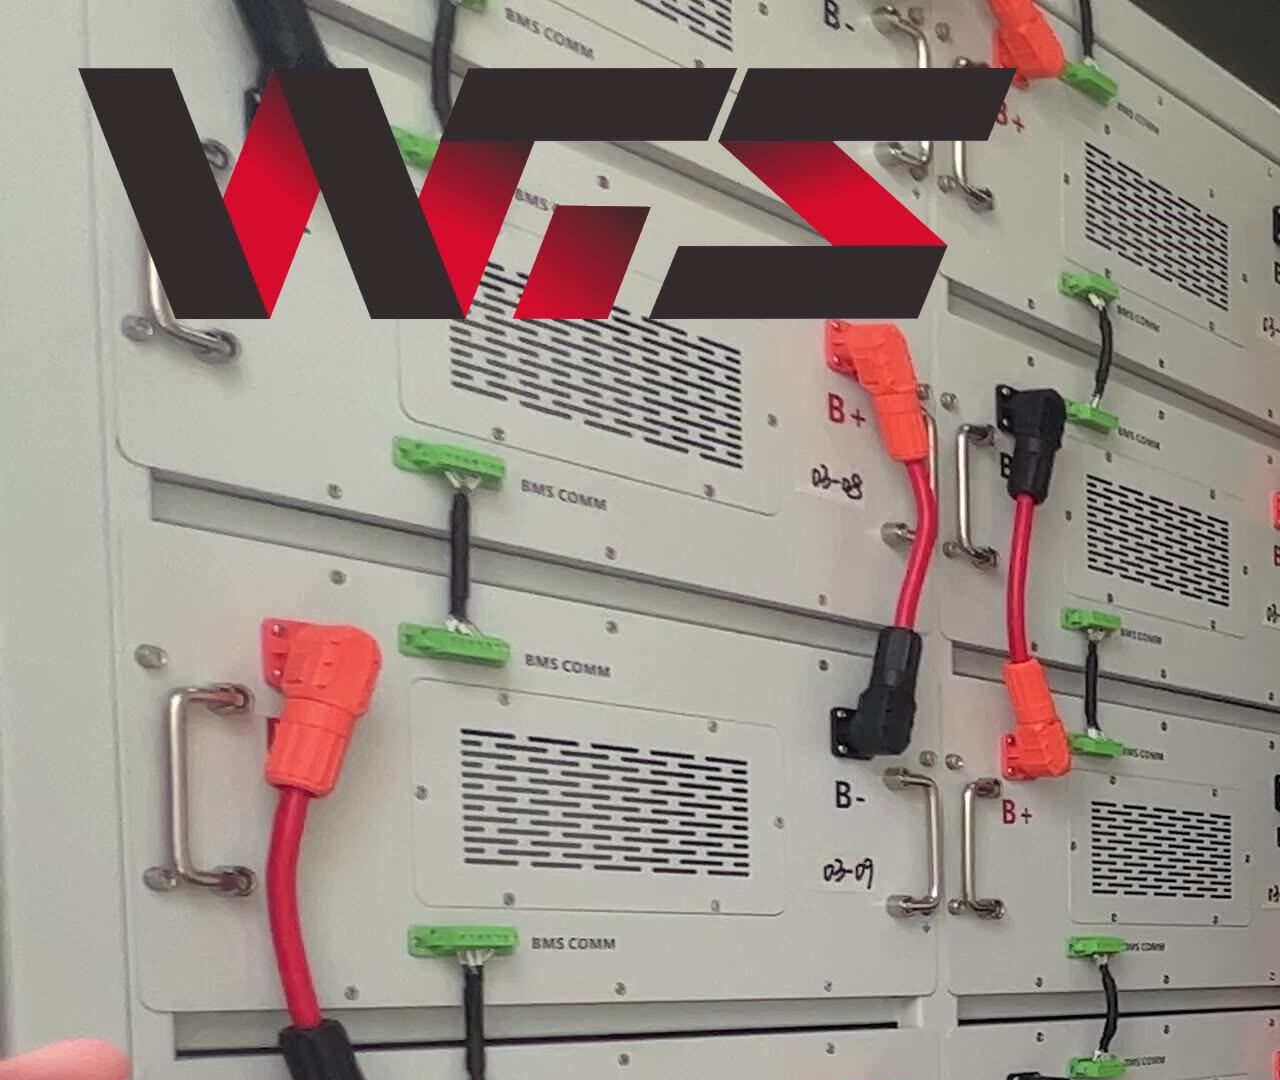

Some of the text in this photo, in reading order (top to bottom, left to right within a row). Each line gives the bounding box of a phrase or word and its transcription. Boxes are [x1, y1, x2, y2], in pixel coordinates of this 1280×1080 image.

[823, 0, 855, 32] B-
[504, 7, 595, 60] BMS COMM
[515, 187, 549, 211] BMS
[827, 392, 866, 428] B+
[520, 479, 607, 511] BMS COMM
[524, 653, 611, 678] BMS COMM
[836, 780, 865, 809] B-
[1002, 798, 1032, 825] B+
[823, 858, 874, 890] 03-09
[531, 937, 616, 950] BMS COMM
